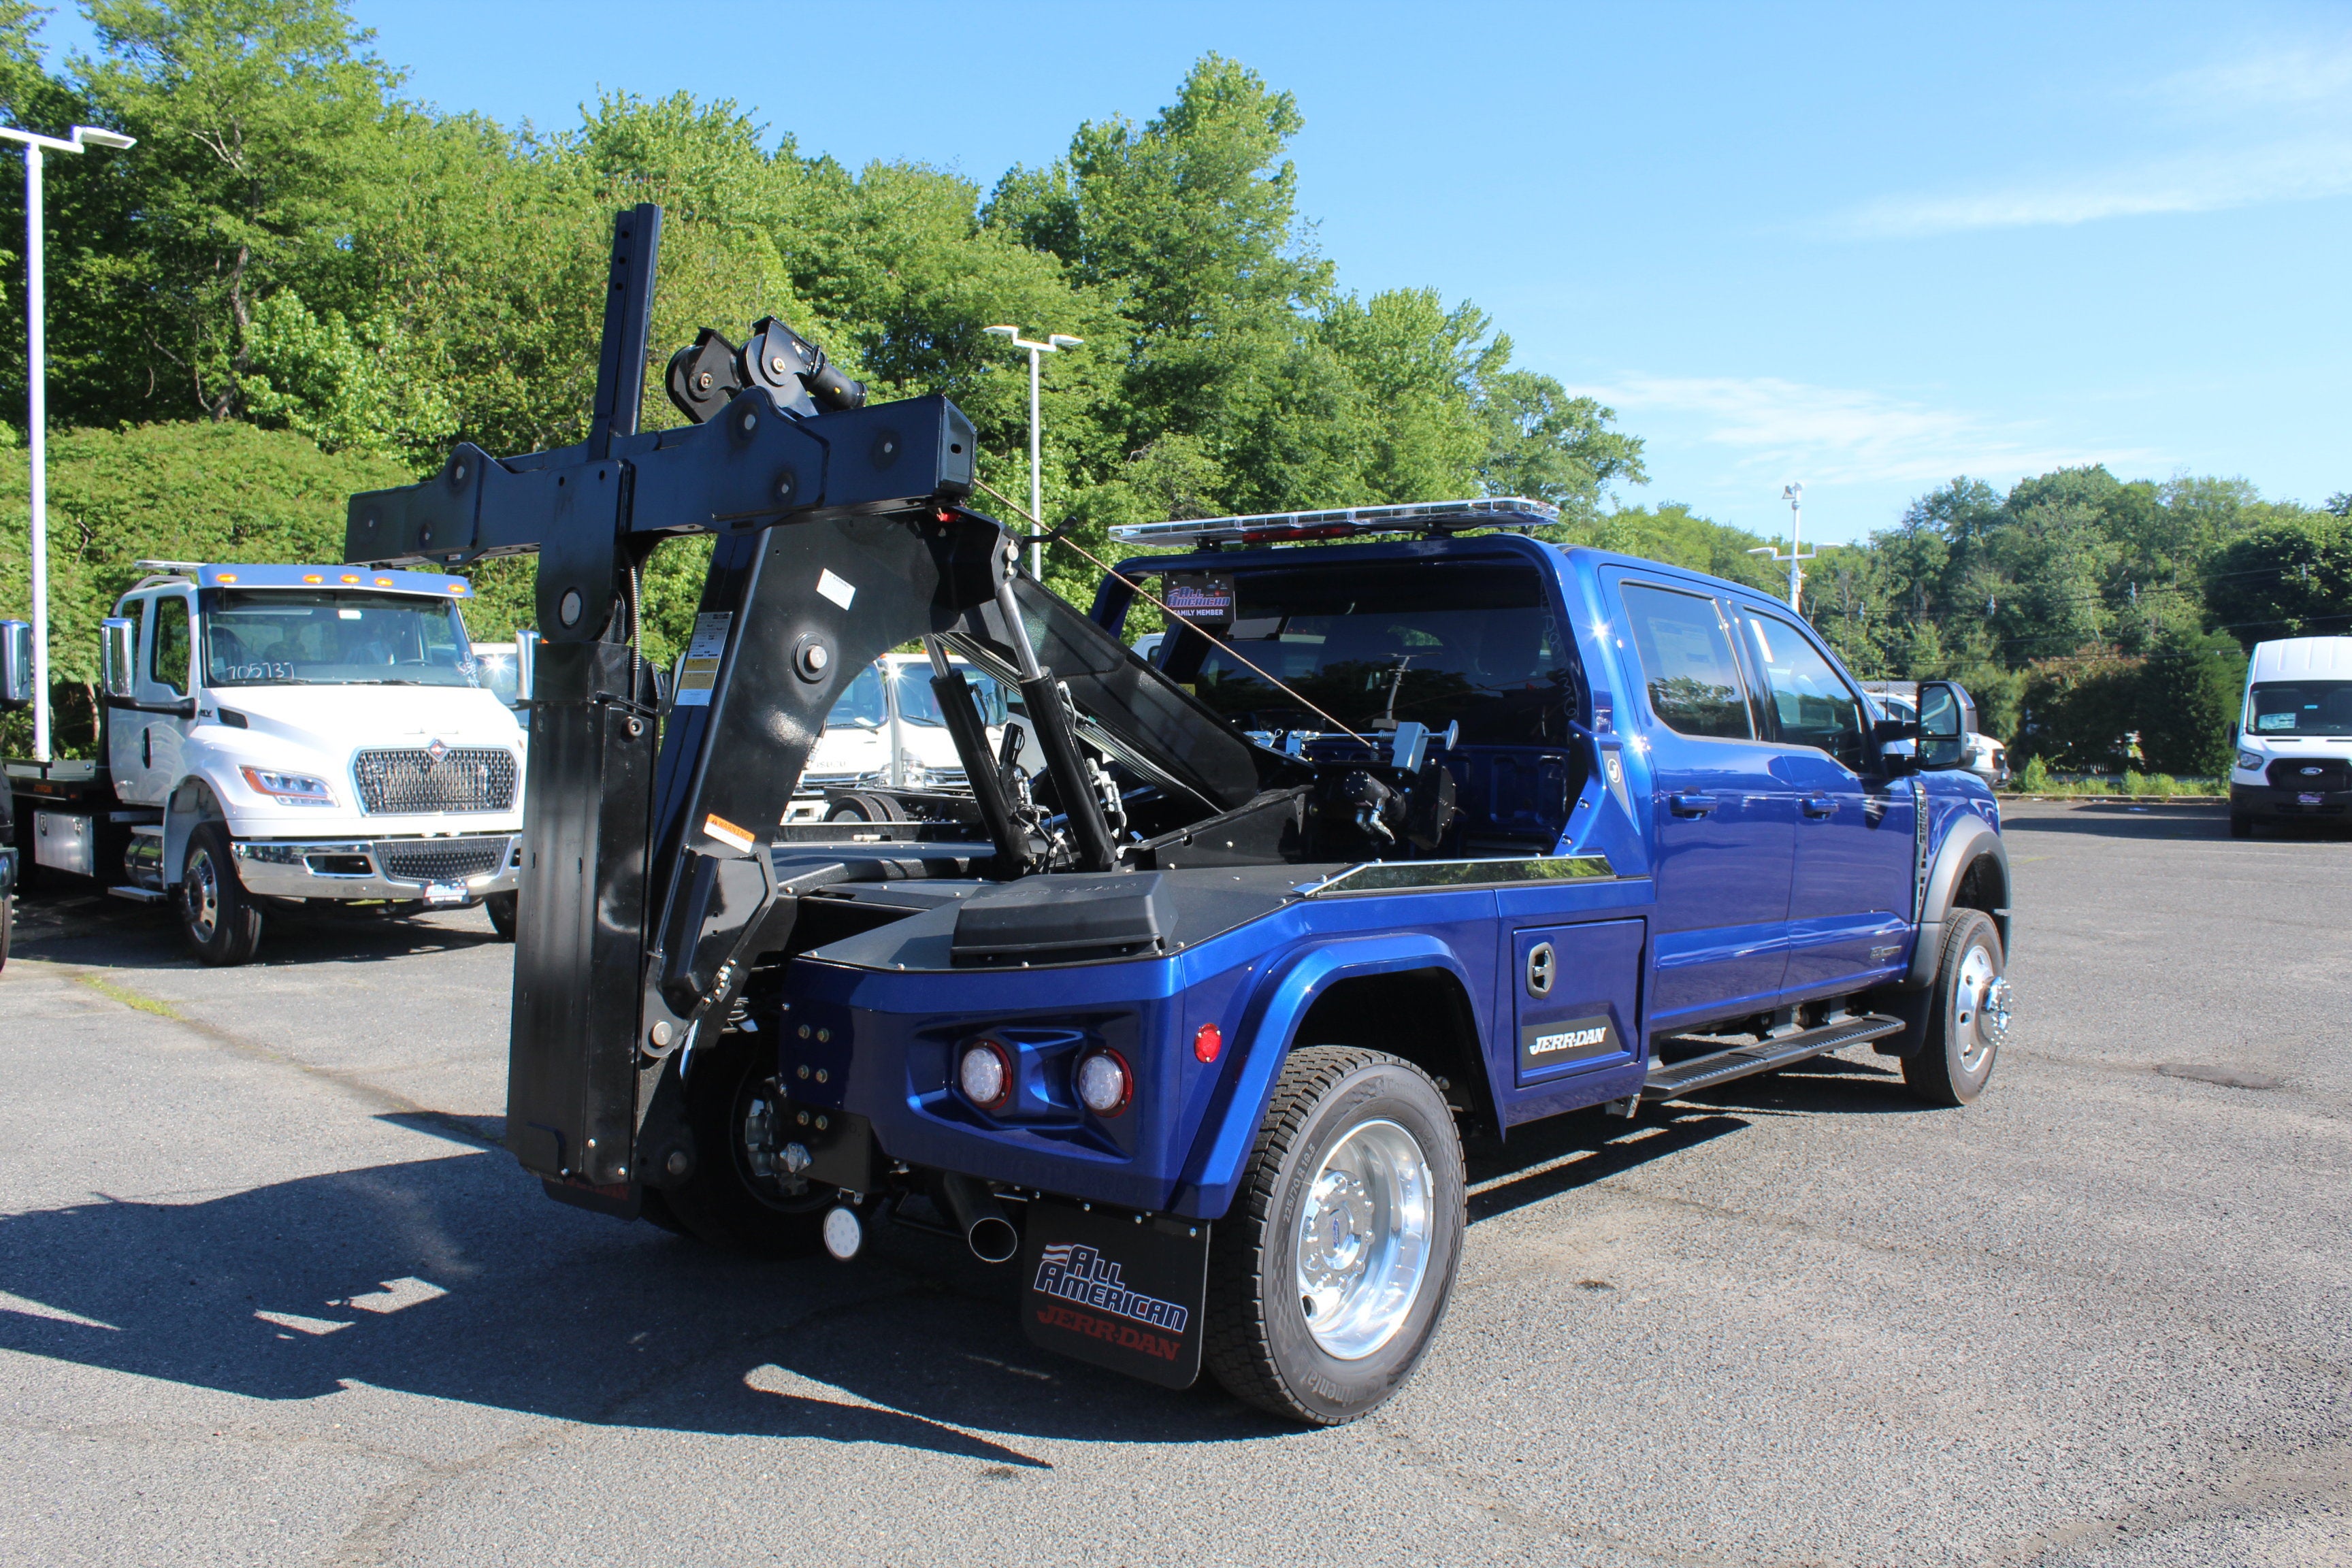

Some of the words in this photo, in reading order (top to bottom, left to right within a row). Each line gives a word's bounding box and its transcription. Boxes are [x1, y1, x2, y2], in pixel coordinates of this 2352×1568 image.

[718, 819, 749, 840] WARNING
[1283, 1178, 1301, 1223] 225/70
[1296, 1167, 1305, 1179] R
[1301, 1143, 1316, 1169] 19.5
[1033, 1260, 1188, 1333] AMERICAN
[1065, 1244, 1125, 1290] ALL
